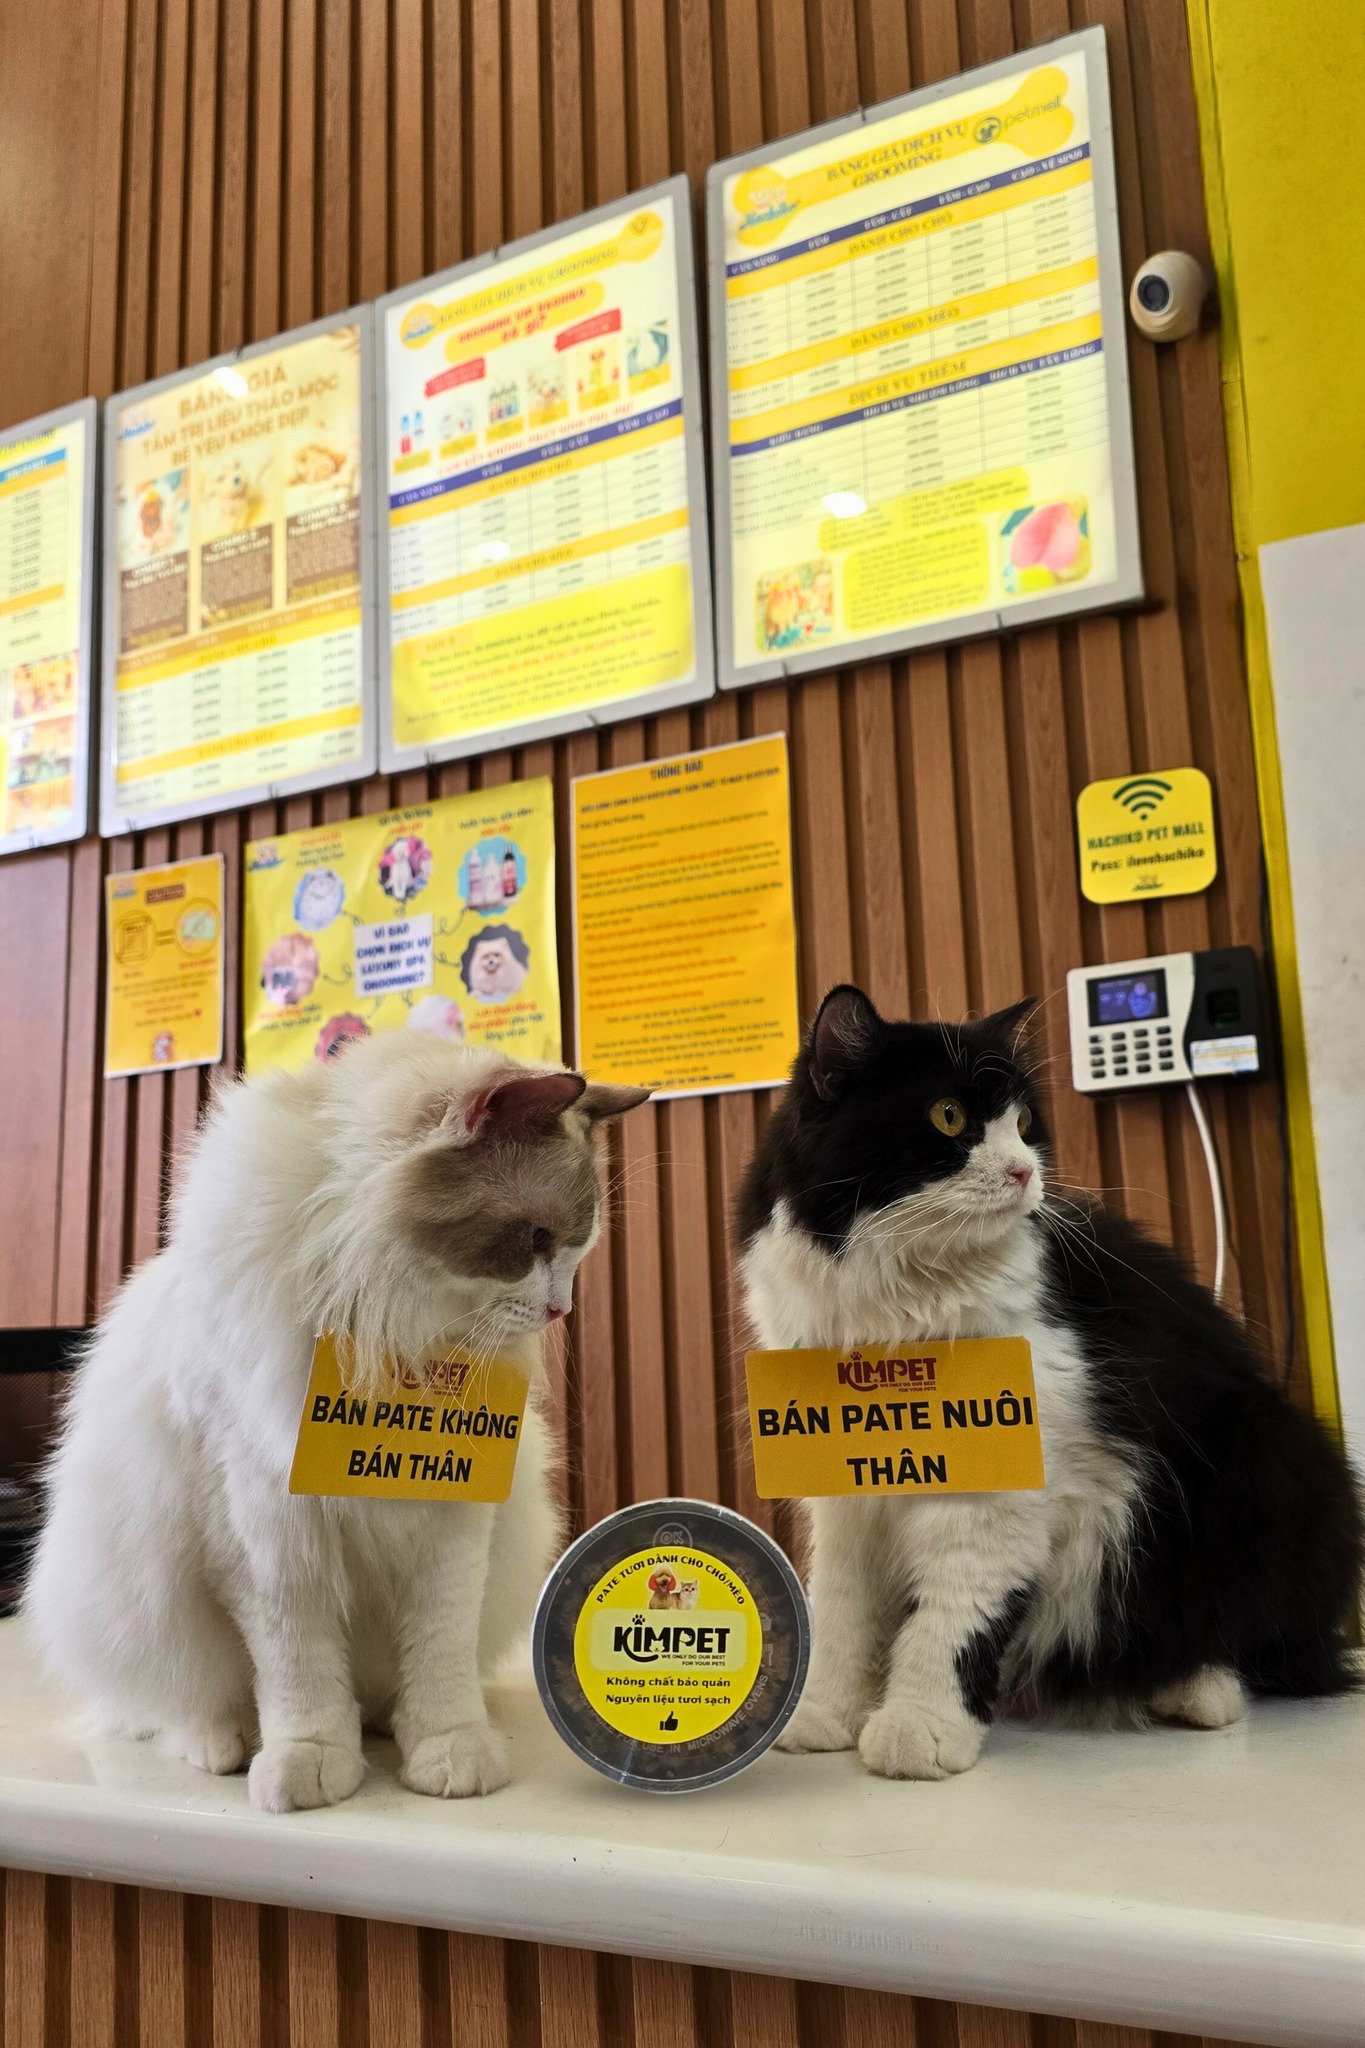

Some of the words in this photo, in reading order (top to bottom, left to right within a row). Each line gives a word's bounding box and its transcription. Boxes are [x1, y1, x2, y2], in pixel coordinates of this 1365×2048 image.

[179, 385, 230, 418] BẢN
[1087, 831, 1143, 849] HACHIKO
[1146, 826, 1168, 842] PET
[1172, 821, 1205, 838] MALL
[361, 959, 401, 975] LUXURY
[837, 1351, 937, 1392] KIMPET
[311, 1391, 367, 1426] BÁN
[373, 1402, 434, 1432] PATE
[440, 1406, 519, 1439] KHÔNG
[758, 1399, 831, 1436] BÁN
[841, 1401, 931, 1433] PATE
[942, 1390, 1034, 1429] NUÔI
[348, 1445, 402, 1479] BÁN
[409, 1450, 472, 1482] THÂN
[846, 1448, 948, 1486] THÂN
[660, 1530, 685, 1545] OK
[596, 1576, 620, 1604] PATE
[619, 1560, 646, 1580] TƯƠI
[647, 1553, 679, 1566] DÀNH
[680, 1555, 704, 1569] CHO
[705, 1564, 745, 1605] CHÓ/MÈO
[614, 1614, 731, 1663] KIMPET
[606, 1676, 646, 1688] Không
[648, 1675, 675, 1687] chất
[677, 1676, 699, 1687] bảo
[701, 1676, 731, 1688] quản
[606, 1694, 650, 1705] Nguyên
[653, 1694, 675, 1706] liệu
[678, 1695, 702, 1704] tươi
[704, 1695, 731, 1706] sạch
[670, 1744, 681, 1754] IN
[688, 1711, 747, 1751] MICROWAVE
[745, 1674, 769, 1712] OVENS
